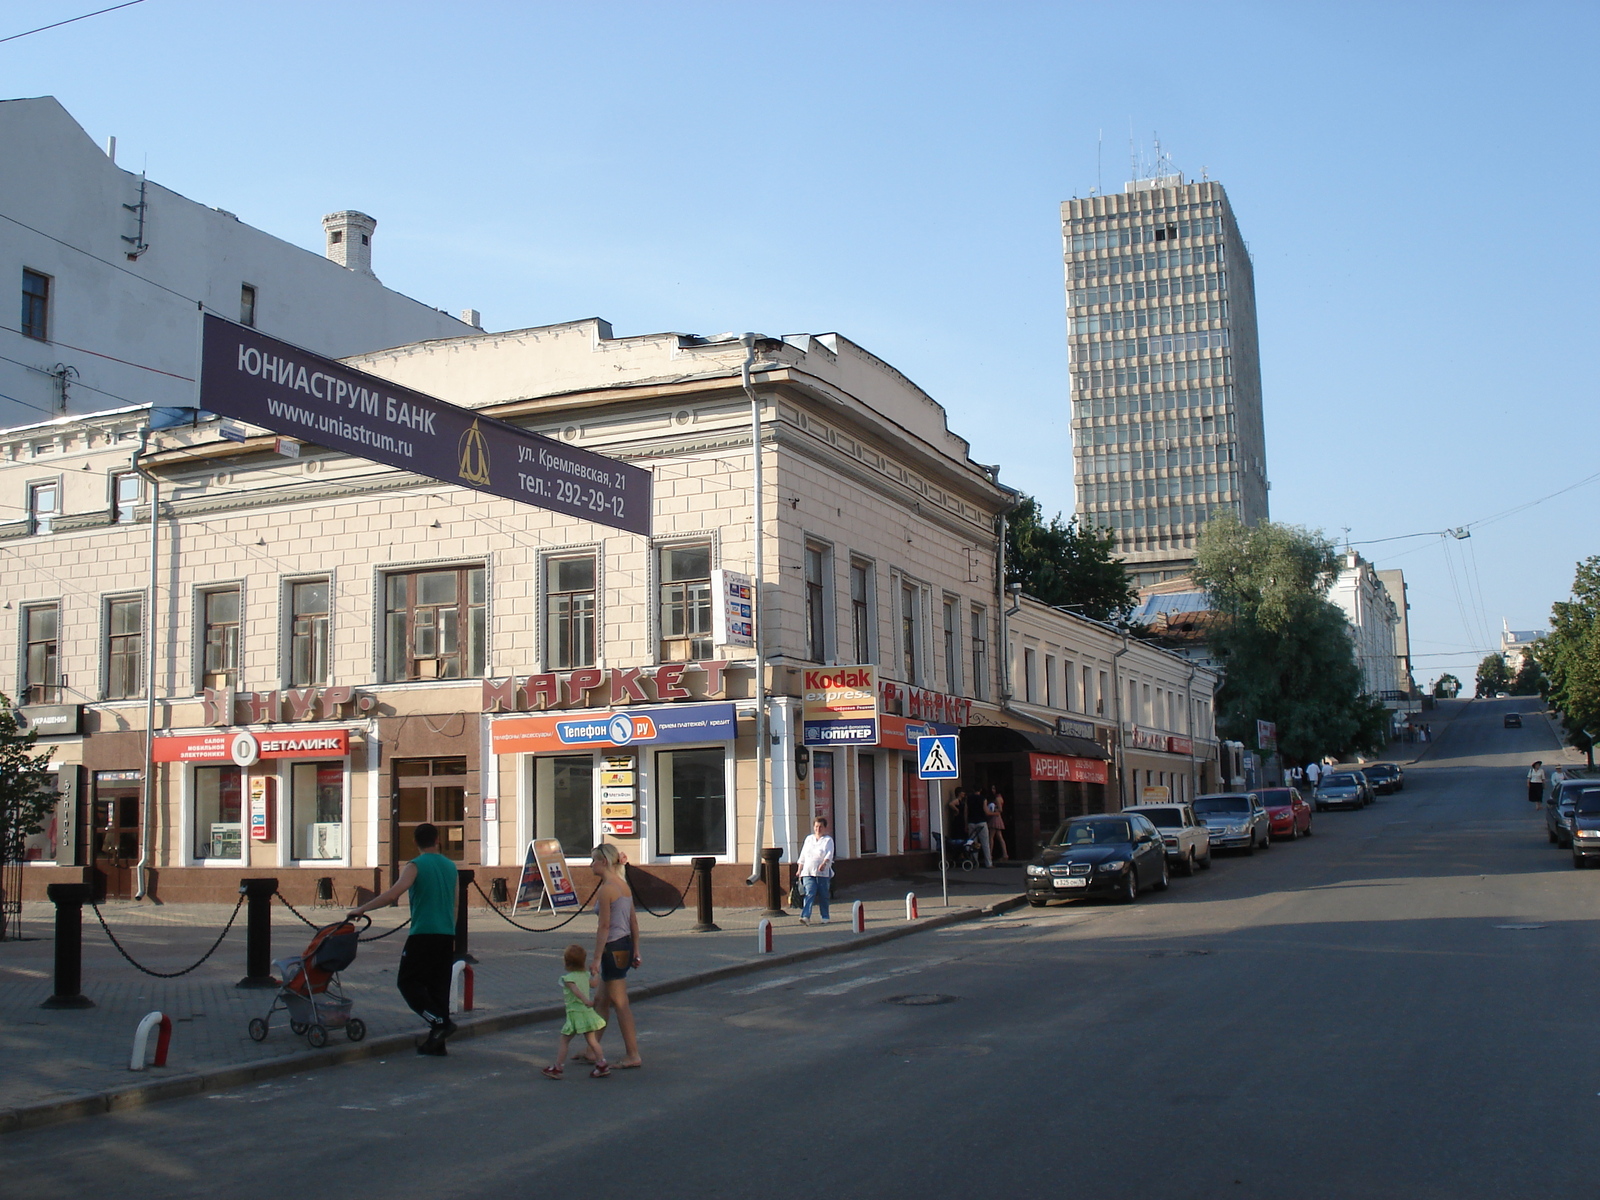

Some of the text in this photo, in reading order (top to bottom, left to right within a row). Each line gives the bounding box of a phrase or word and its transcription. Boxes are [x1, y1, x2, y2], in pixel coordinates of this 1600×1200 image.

[238, 344, 436, 435] ЮНИАСТРУМ БАНК
[267, 398, 413, 457] www.uniastrum.ru
[518, 445, 626, 490] ул. Кремлевская, 21
[518, 472, 625, 518] тел.: 292-29-12
[482, 660, 731, 711] МАРКЕТ
[805, 669, 872, 690] Kodak
[805, 689, 872, 703] express
[909, 686, 972, 727] МАРКЕТ
[32, 716, 67, 726] УКРАШЕНИЯ
[564, 723, 607, 739] Телефон
[261, 738, 339, 752] БЕТАЛИНК
[821, 729, 872, 739] ЮПИТЕР
[1035, 758, 1071, 780] АРЕНДА
